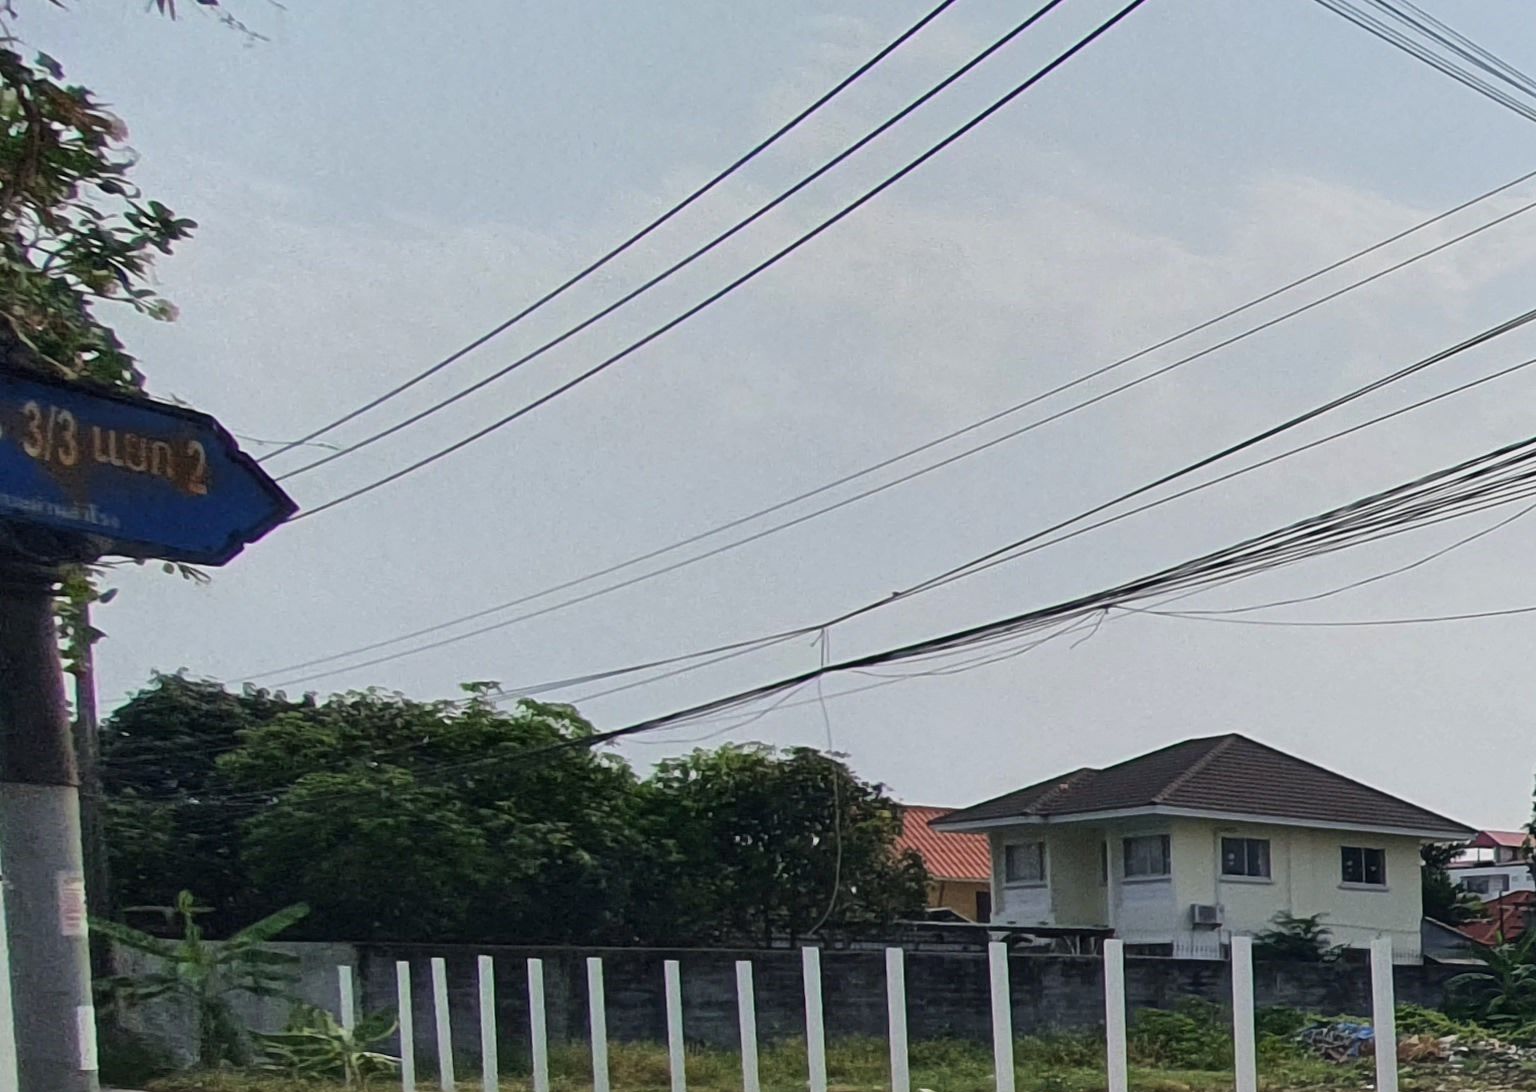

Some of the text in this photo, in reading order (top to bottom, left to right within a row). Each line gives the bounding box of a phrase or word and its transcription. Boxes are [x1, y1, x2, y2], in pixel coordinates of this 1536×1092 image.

[23, 401, 208, 496] 3/3 แยก 2
